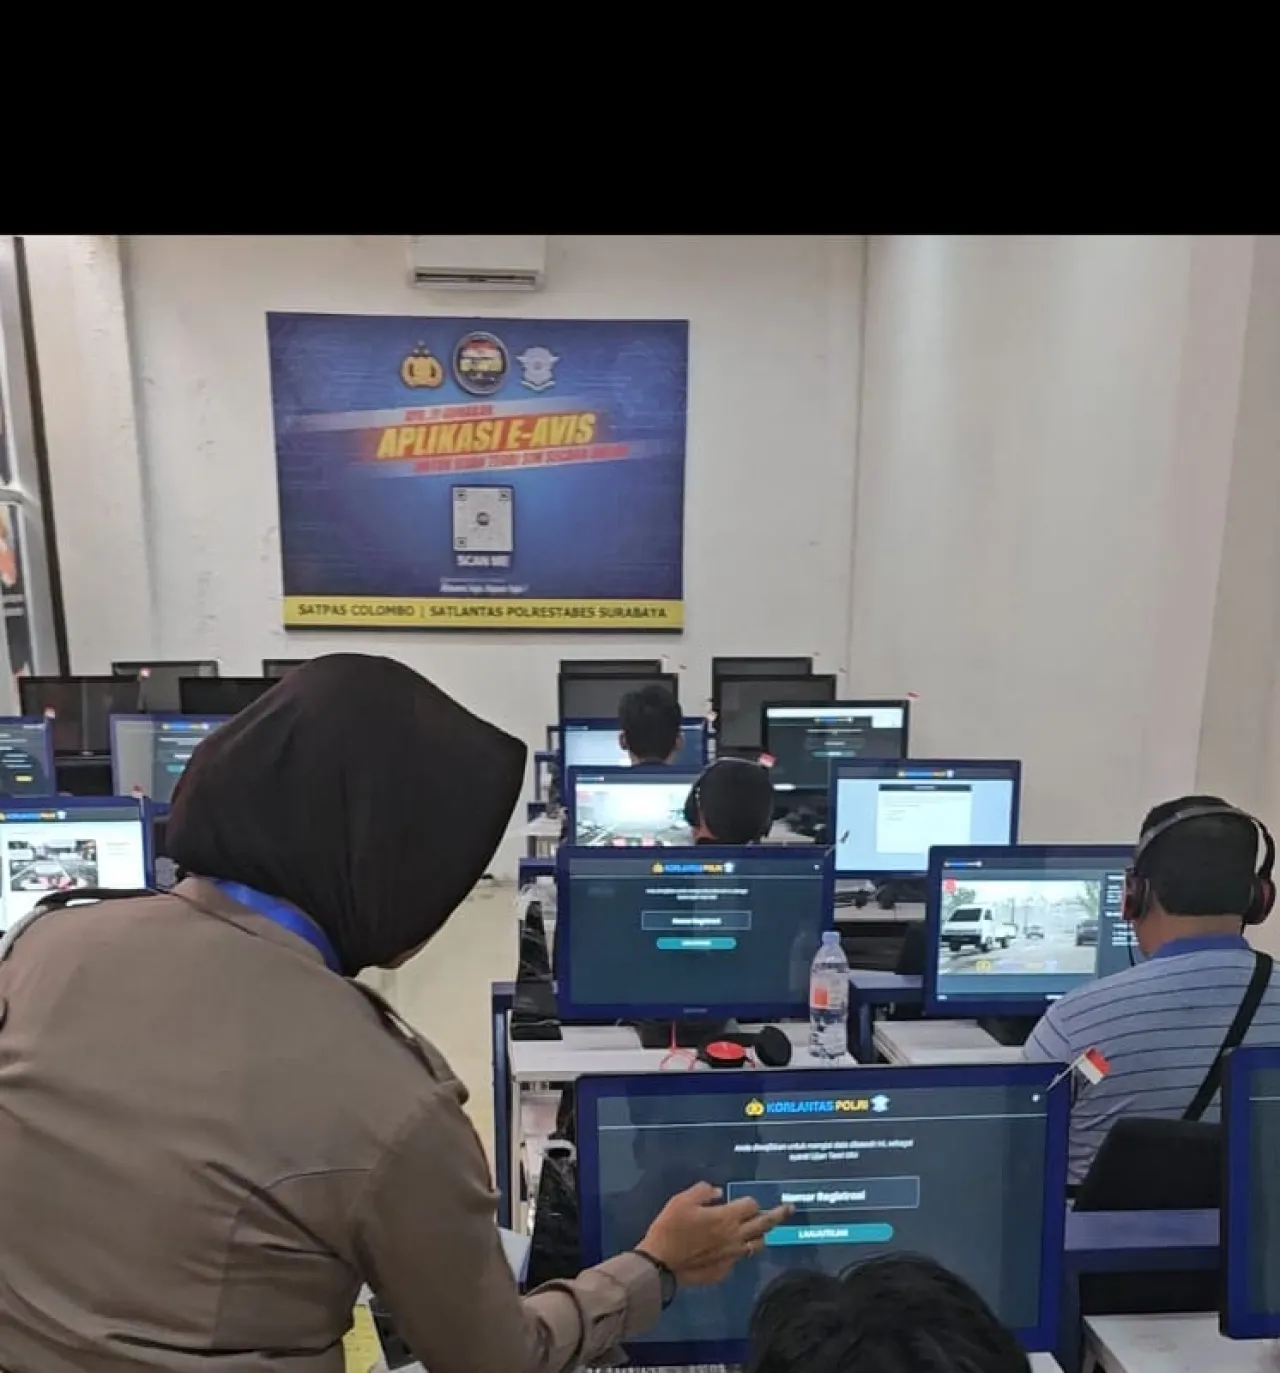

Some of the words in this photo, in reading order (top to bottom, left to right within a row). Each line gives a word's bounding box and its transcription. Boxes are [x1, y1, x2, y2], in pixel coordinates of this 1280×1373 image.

[377, 419, 504, 459] APLIKASI
[507, 413, 596, 449] E-AVIS
[457, 555, 489, 567] SCAN
[297, 603, 347, 616] SATPAS
[351, 604, 415, 617] COLOMBO
[430, 605, 504, 618] SATLANTAS
[507, 605, 596, 619] POLRESTABES
[598, 605, 668, 619] SURABAYA
[766, 1100, 834, 1113] KORLANTAS
[835, 1099, 869, 1112] POLRI
